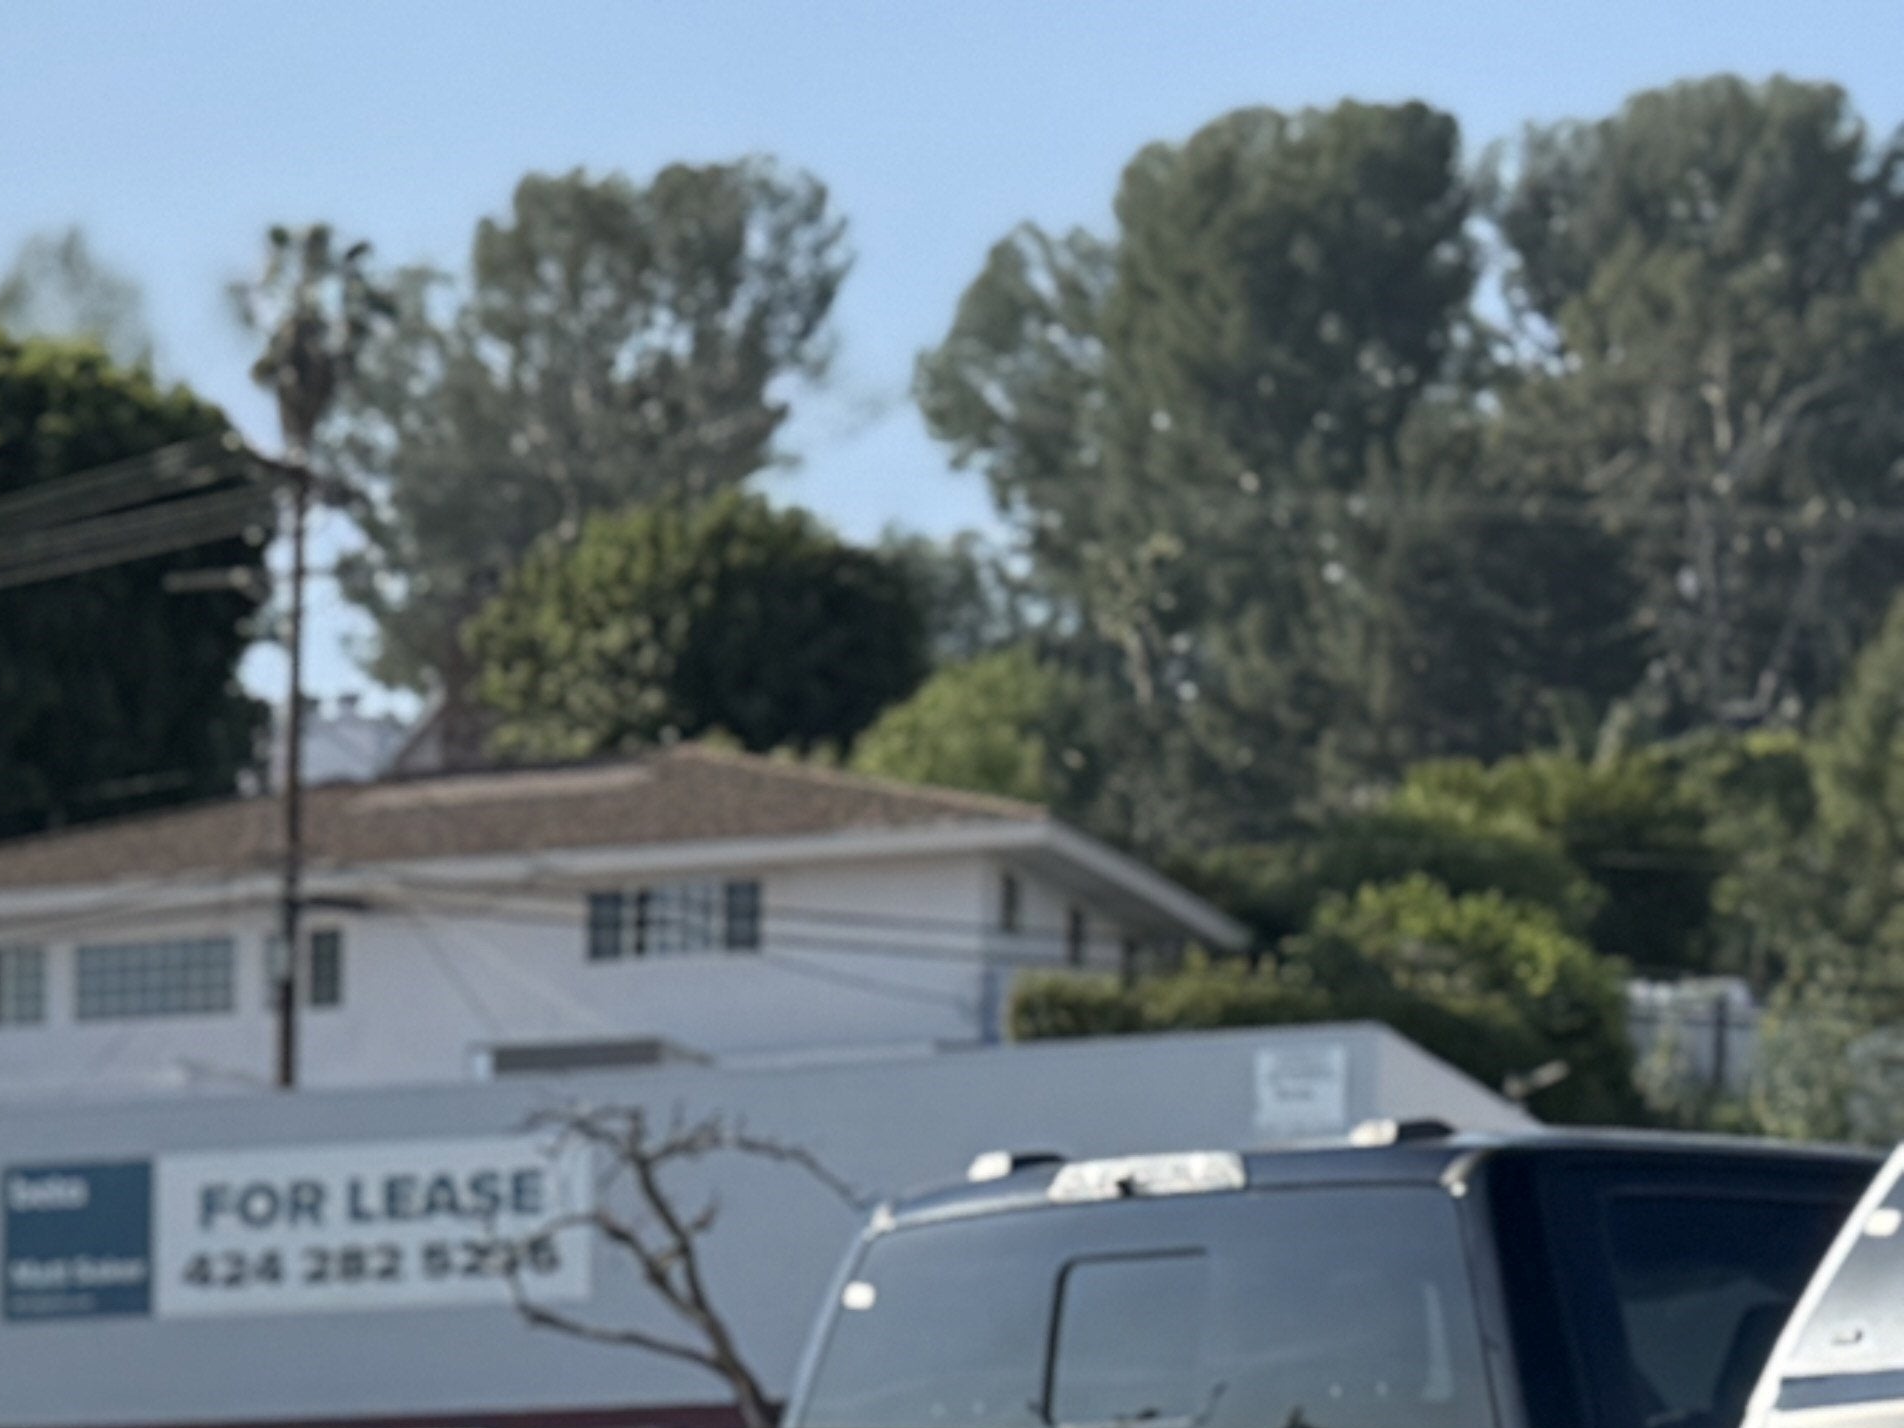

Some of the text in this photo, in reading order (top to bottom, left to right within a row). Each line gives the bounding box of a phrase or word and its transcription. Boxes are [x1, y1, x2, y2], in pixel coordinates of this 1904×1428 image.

[200, 1168, 546, 1231] FOR LEASE
[183, 1246, 283, 1290] 424
